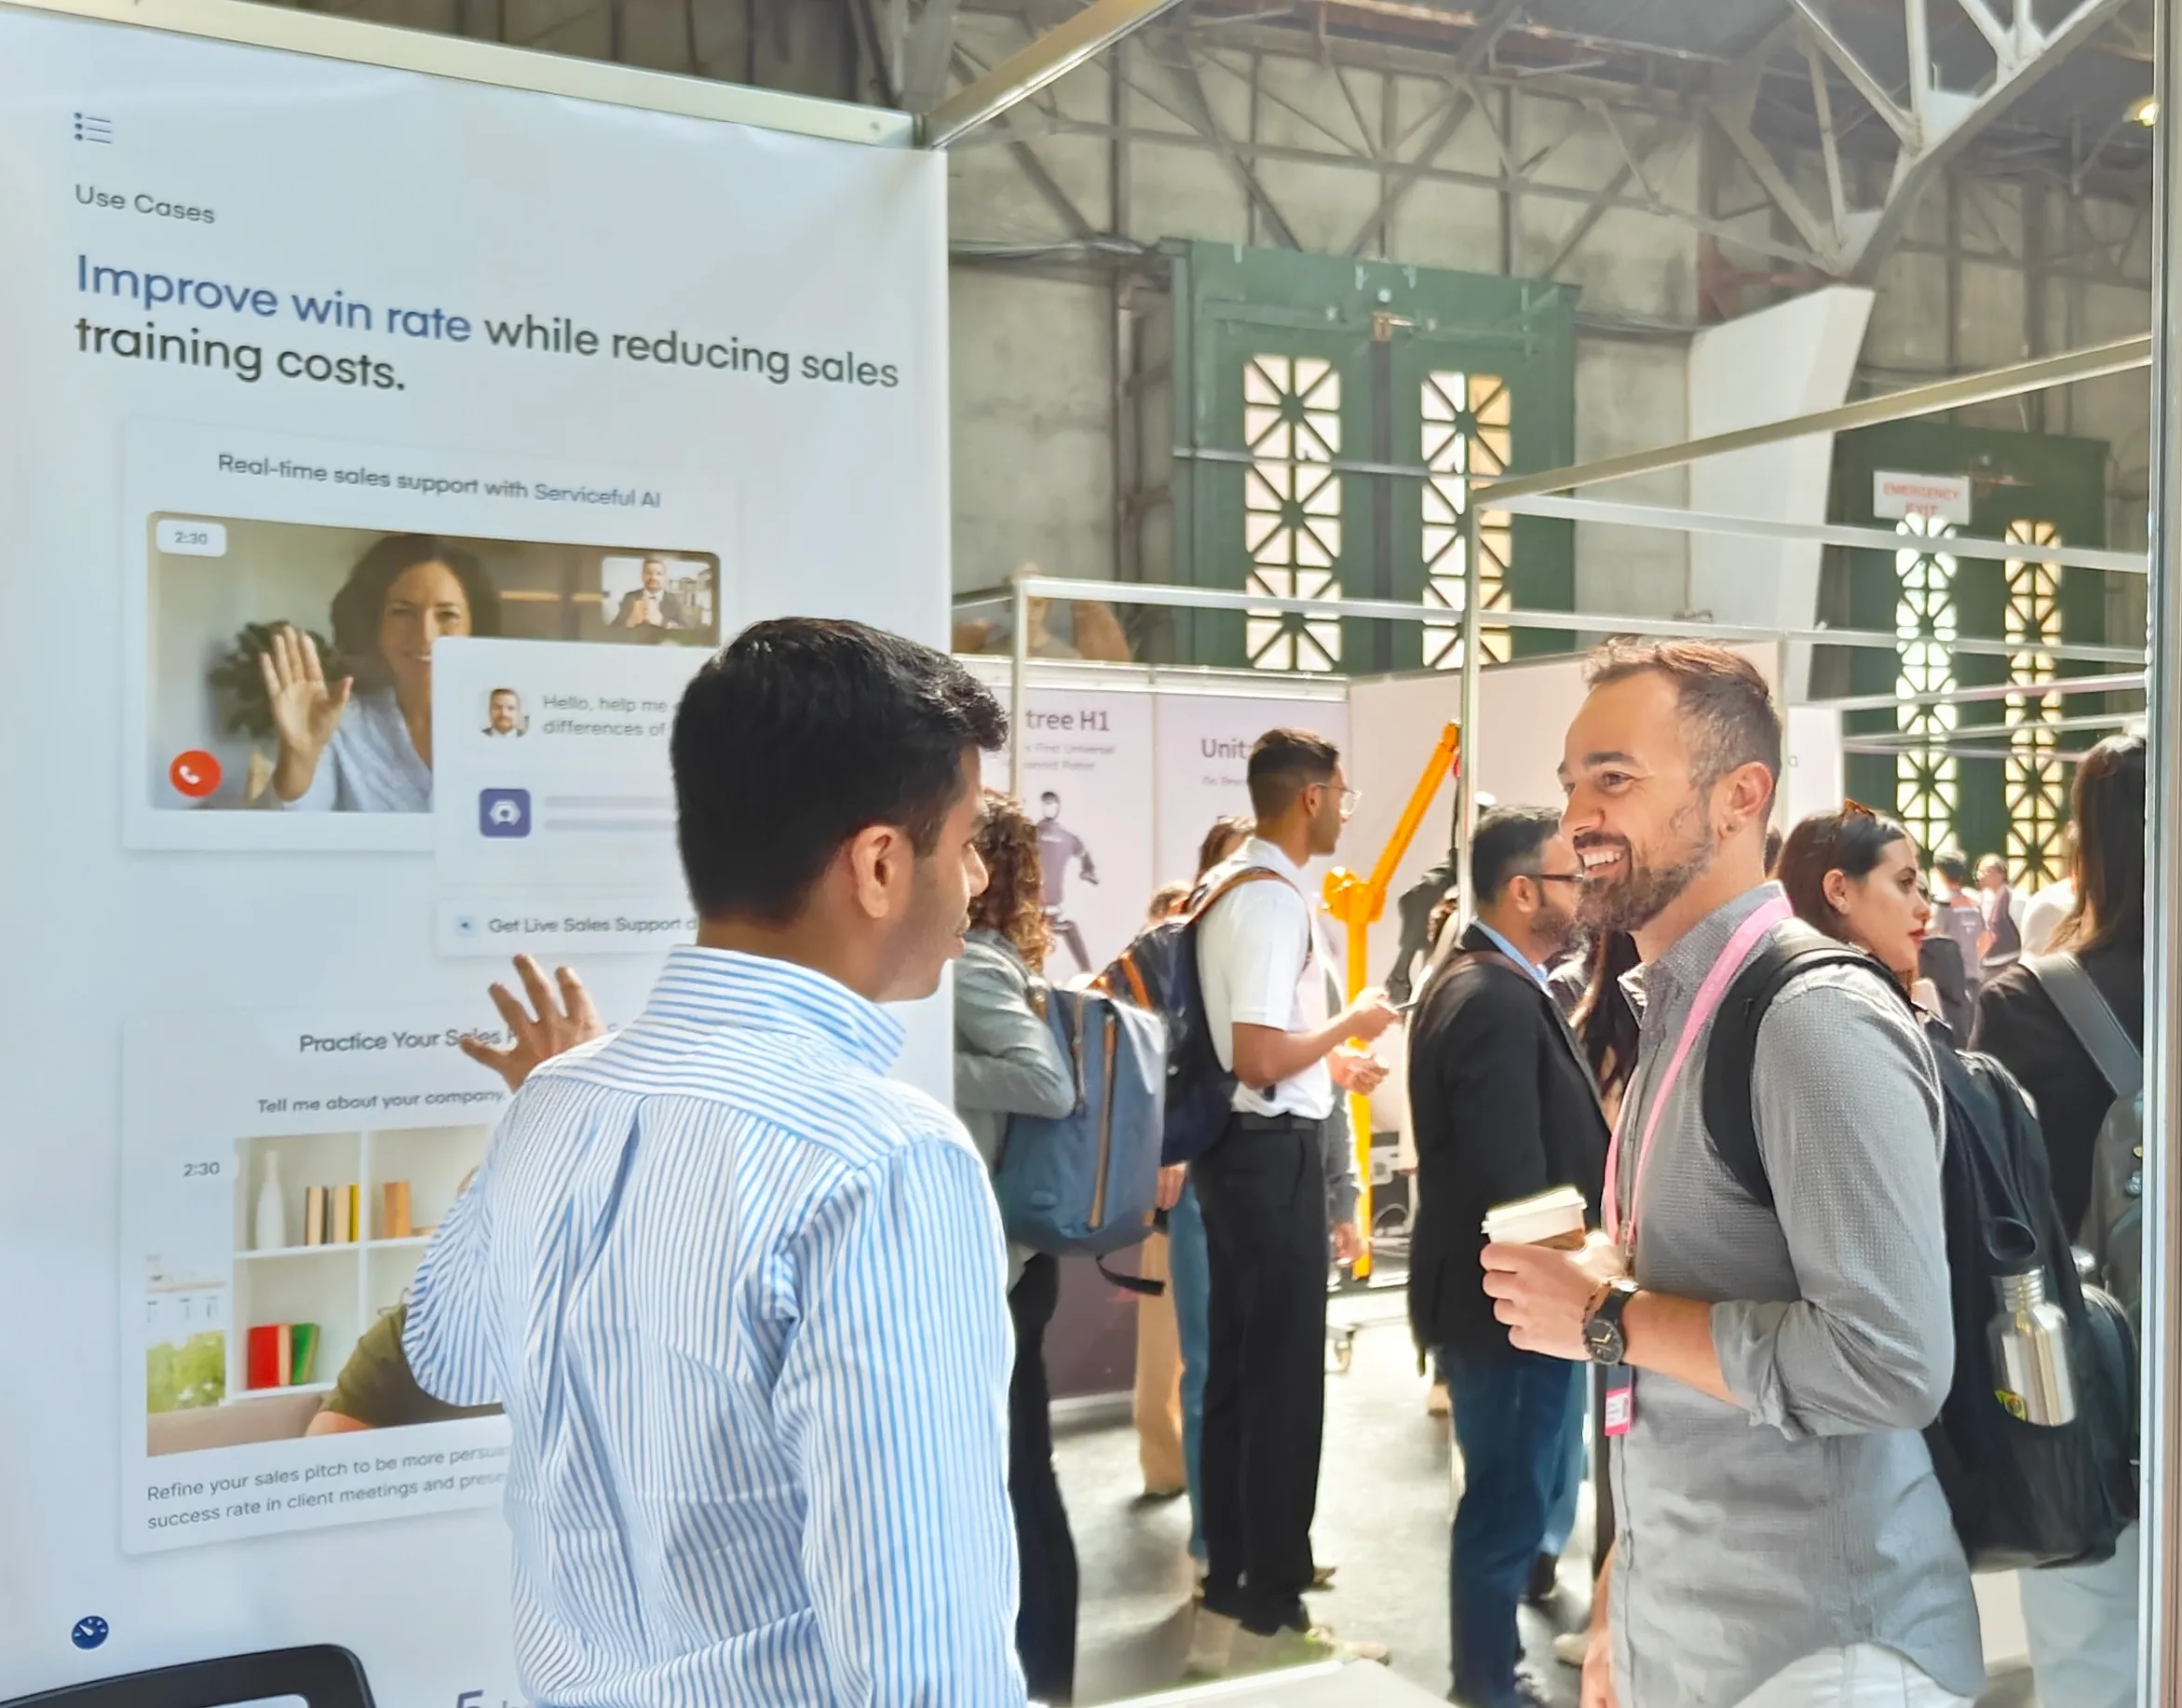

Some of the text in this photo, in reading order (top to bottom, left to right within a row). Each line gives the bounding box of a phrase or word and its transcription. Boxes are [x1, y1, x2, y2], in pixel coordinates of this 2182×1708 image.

[75, 184, 215, 224] Use Cases
[78, 255, 899, 387] Improve win rate while reducing sales
[75, 315, 404, 390] training costs.
[219, 454, 660, 508] Real-time sales support with Serviceful AI
[175, 531, 208, 545] 2:30
[543, 695, 668, 714] Hello, help me
[543, 720, 666, 736] differences of
[1080, 711, 1109, 731] H1
[488, 918, 521, 933] Get
[523, 918, 559, 933] Live
[563, 917, 611, 932] Sales
[614, 916, 681, 934] Support
[300, 1033, 387, 1052] Practice
[392, 1032, 440, 1048] Your
[257, 1091, 507, 1113] Tell me about your company.
[183, 1161, 220, 1177] 2:30
[148, 1483, 204, 1501] Refine
[210, 1476, 249, 1496] your
[254, 1471, 299, 1486] sales
[305, 1463, 347, 1483] pitch
[354, 1462, 371, 1473] to
[375, 1458, 397, 1471] be
[401, 1453, 444, 1468] more
[148, 1508, 221, 1529] success
[226, 1502, 261, 1517] rate
[266, 1498, 281, 1511] in
[287, 1492, 333, 1509] client
[340, 1483, 418, 1502] meetings
[423, 1476, 454, 1492] and
